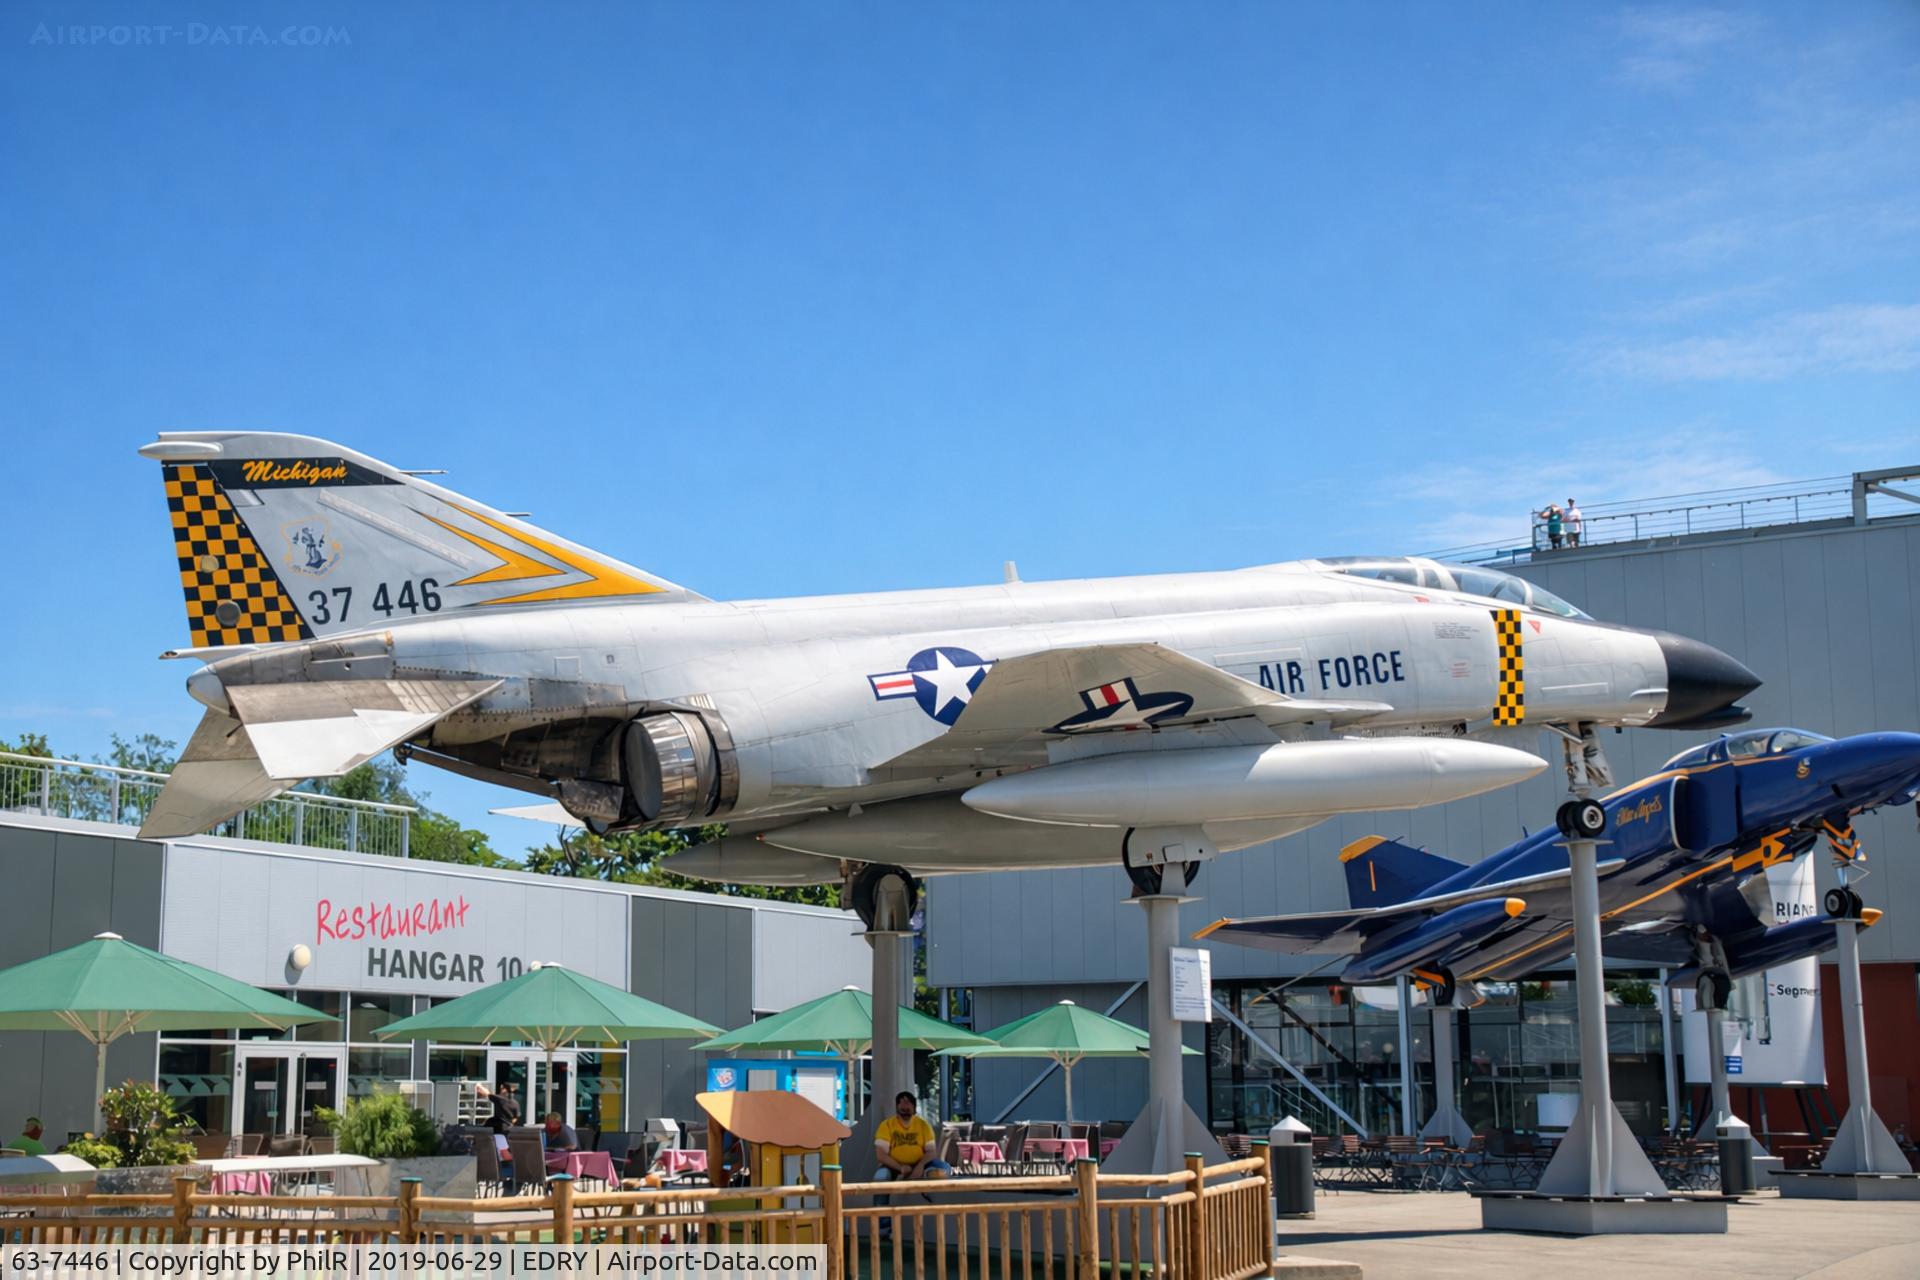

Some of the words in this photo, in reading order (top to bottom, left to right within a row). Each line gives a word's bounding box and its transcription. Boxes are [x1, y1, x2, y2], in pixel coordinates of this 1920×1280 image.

[242, 460, 349, 486] Michigan
[308, 586, 353, 626] 37
[372, 577, 442, 617] 446
[1259, 661, 1305, 695] AIR
[1318, 650, 1405, 691] FORCE
[367, 947, 485, 984] HANGAR
[497, 956, 522, 982] 10
